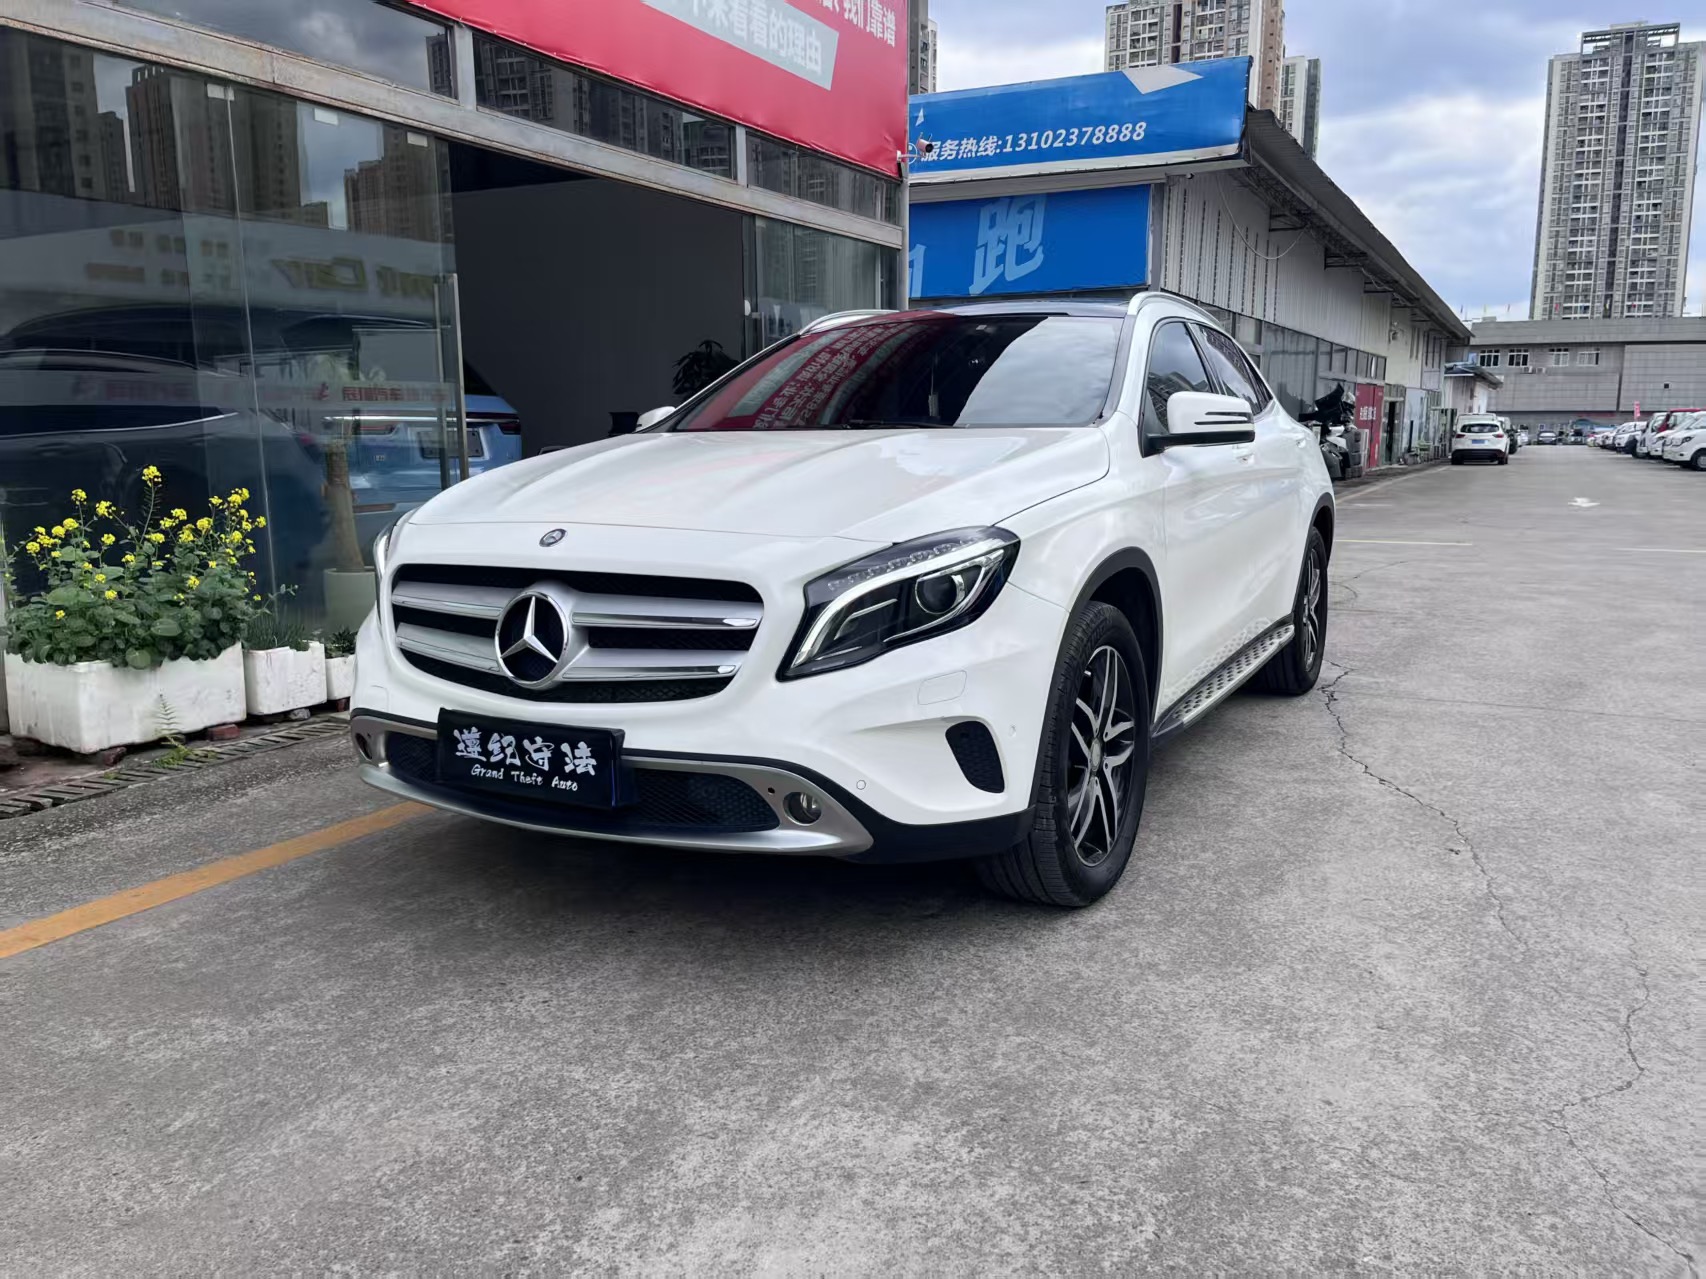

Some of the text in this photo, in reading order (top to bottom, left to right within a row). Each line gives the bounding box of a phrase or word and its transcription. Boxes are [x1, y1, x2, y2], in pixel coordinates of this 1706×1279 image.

[921, 121, 1147, 162] 服务热线:13102378888
[452, 726, 598, 776] 遵纪守法
[470, 763, 579, 792] Grand Theft Auto
